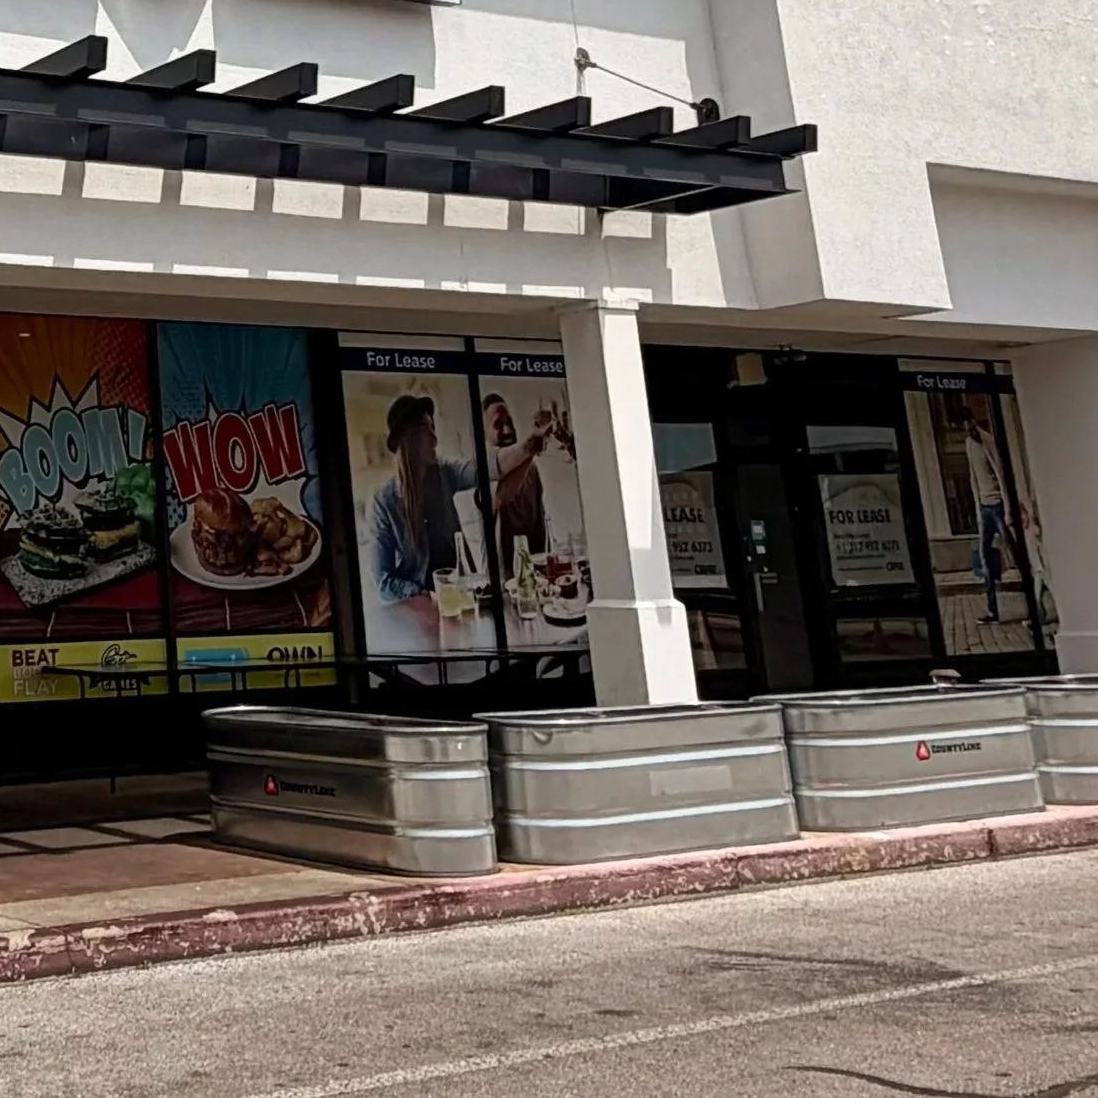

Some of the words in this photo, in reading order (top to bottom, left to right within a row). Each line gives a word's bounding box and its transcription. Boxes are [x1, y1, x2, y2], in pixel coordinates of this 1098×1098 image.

[366, 351, 390, 367] For
[395, 353, 436, 369] Lease
[500, 357, 523, 372] For
[526, 358, 564, 373] Lease
[916, 374, 935, 388] For
[936, 375, 967, 389] Lease
[163, 403, 306, 502] WOW
[664, 507, 705, 524] LEASE
[828, 509, 854, 524] FOR
[857, 508, 892, 524] LEASE
[12, 649, 59, 667] BEAT
[13, 679, 59, 697] FLAY
